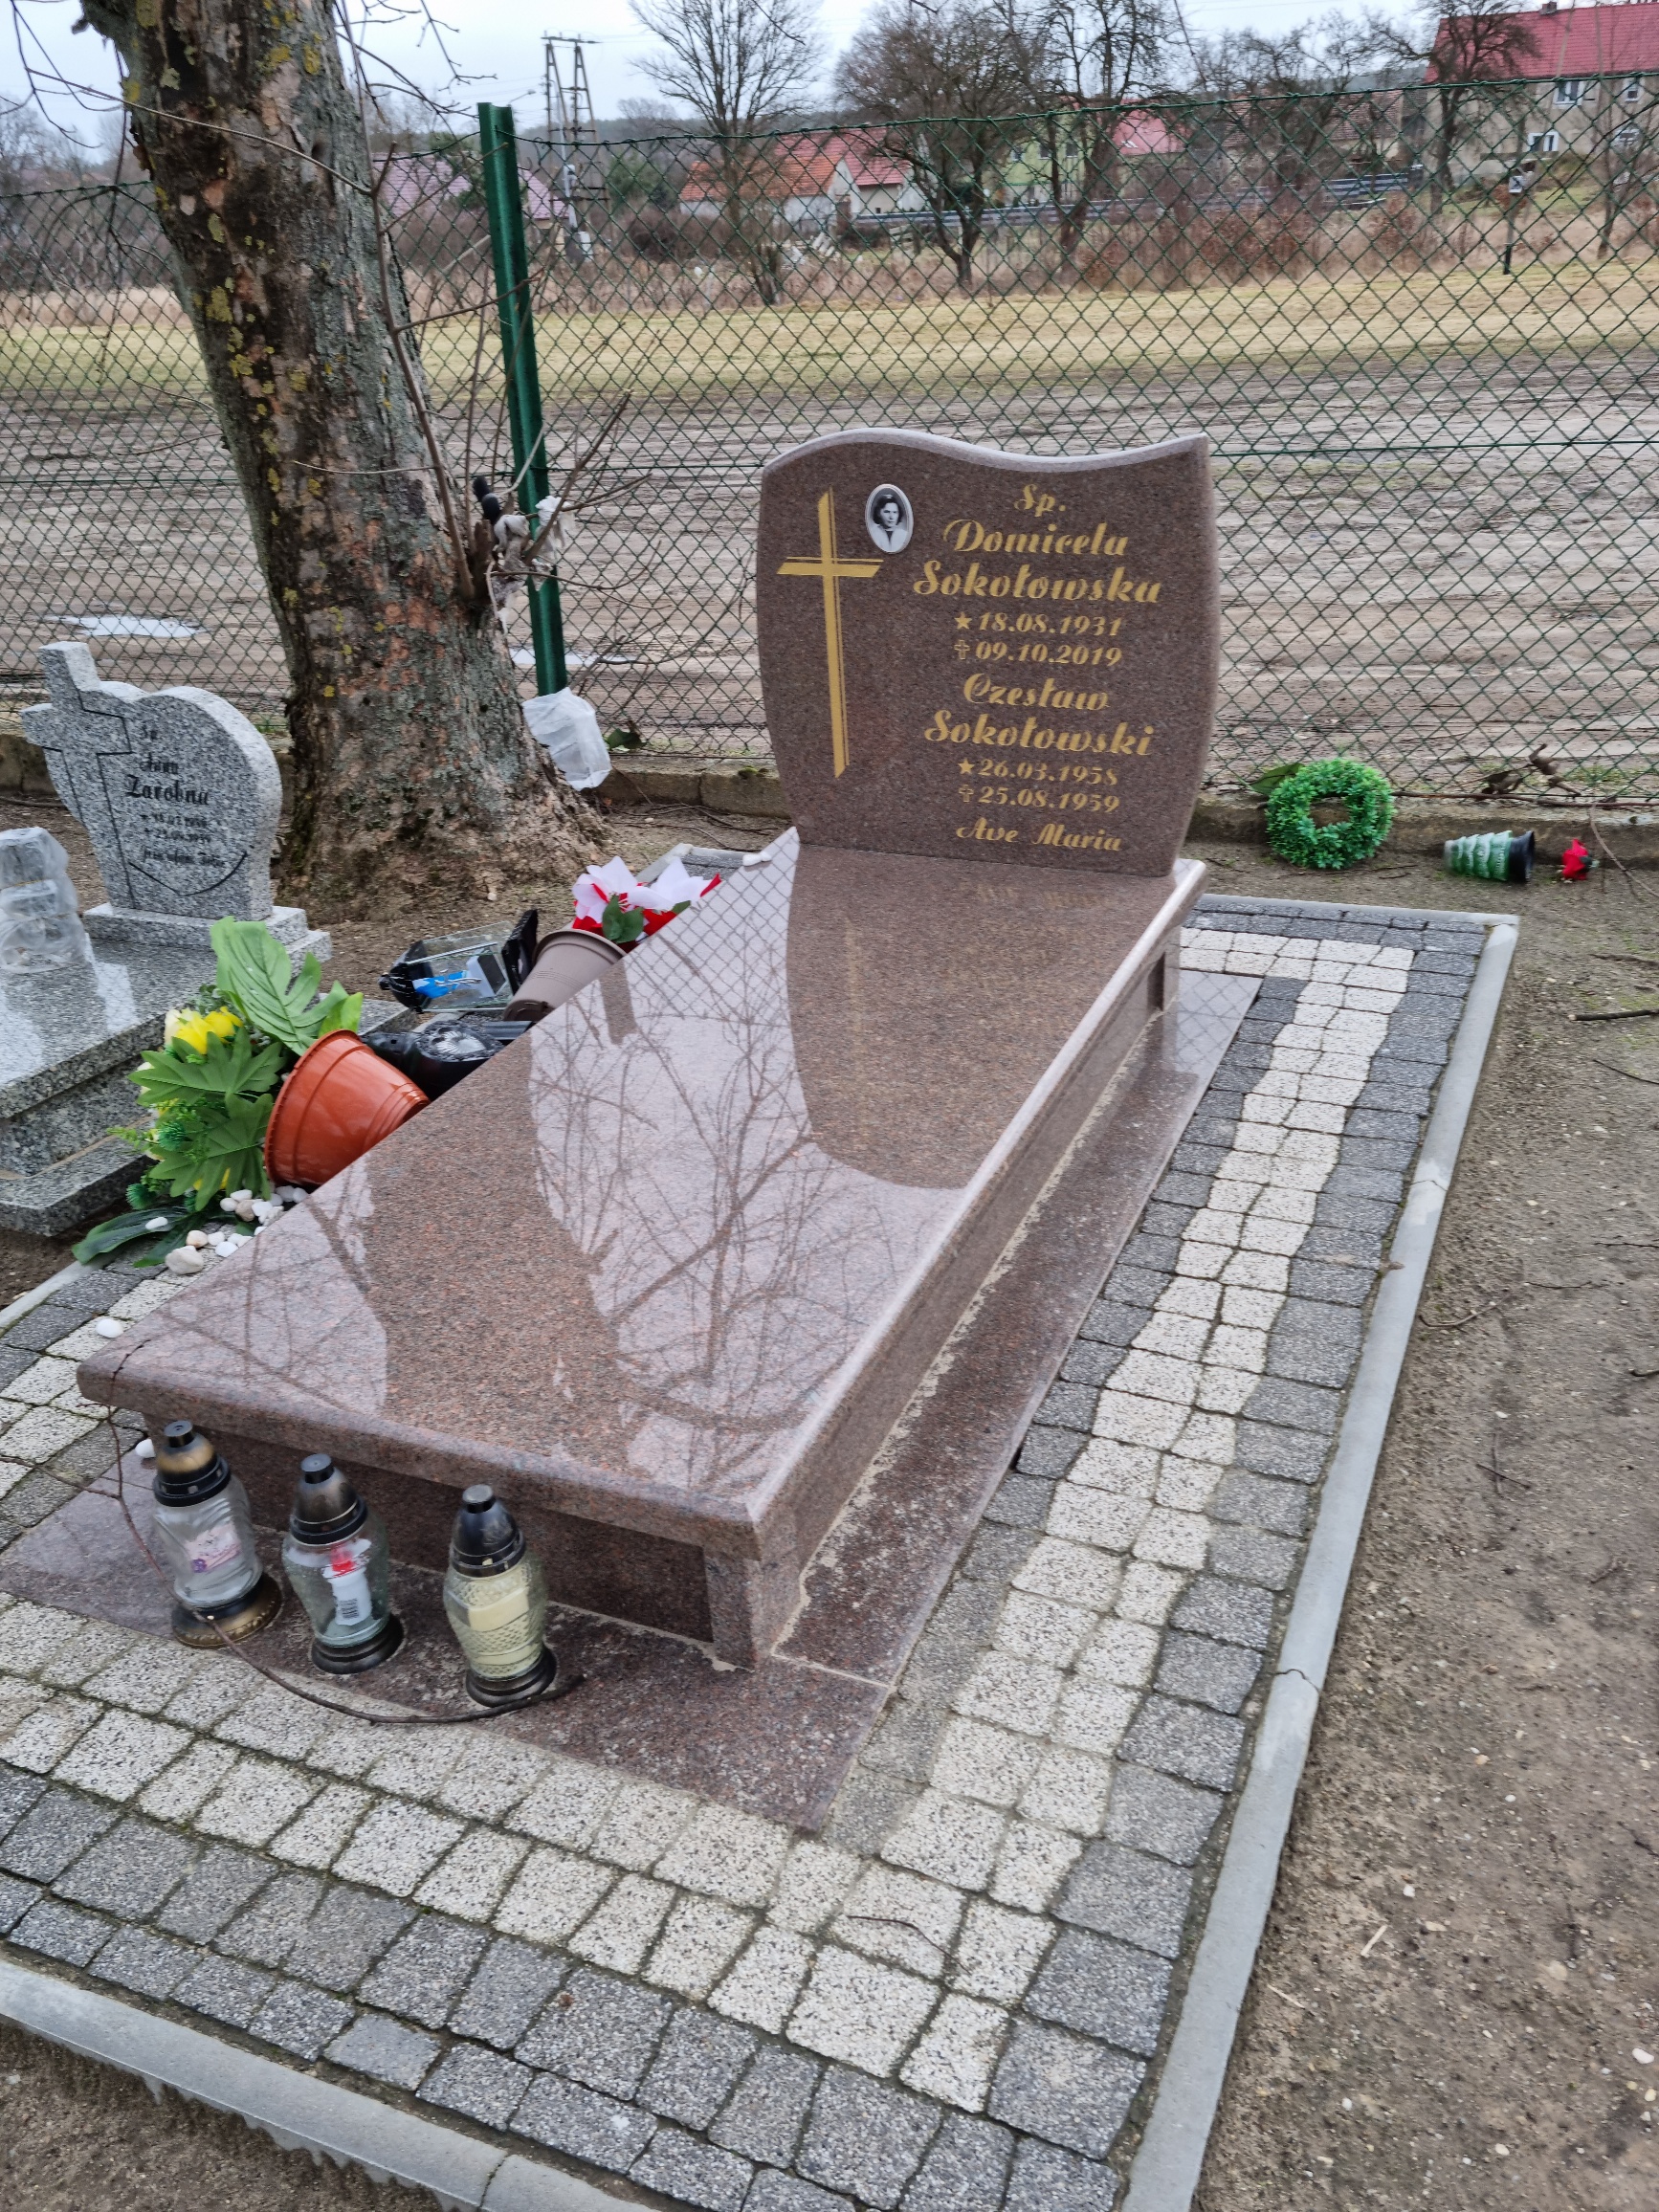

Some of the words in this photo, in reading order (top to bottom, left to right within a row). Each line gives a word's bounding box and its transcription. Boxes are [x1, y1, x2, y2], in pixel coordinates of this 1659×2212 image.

[943, 520, 1128, 556] Domicela
[914, 561, 1161, 603] Sokołowska
[980, 612, 1121, 636] 18.08.1931
[976, 642, 1122, 666] 09.10.2019
[964, 674, 1108, 710] Czesław
[924, 709, 1153, 756] Sokołowski
[980, 760, 1117, 785] 26.03.1958
[980, 787, 1119, 811] 25.08.1959
[957, 819, 1017, 842] Ave
[1032, 824, 1120, 851] Maria
